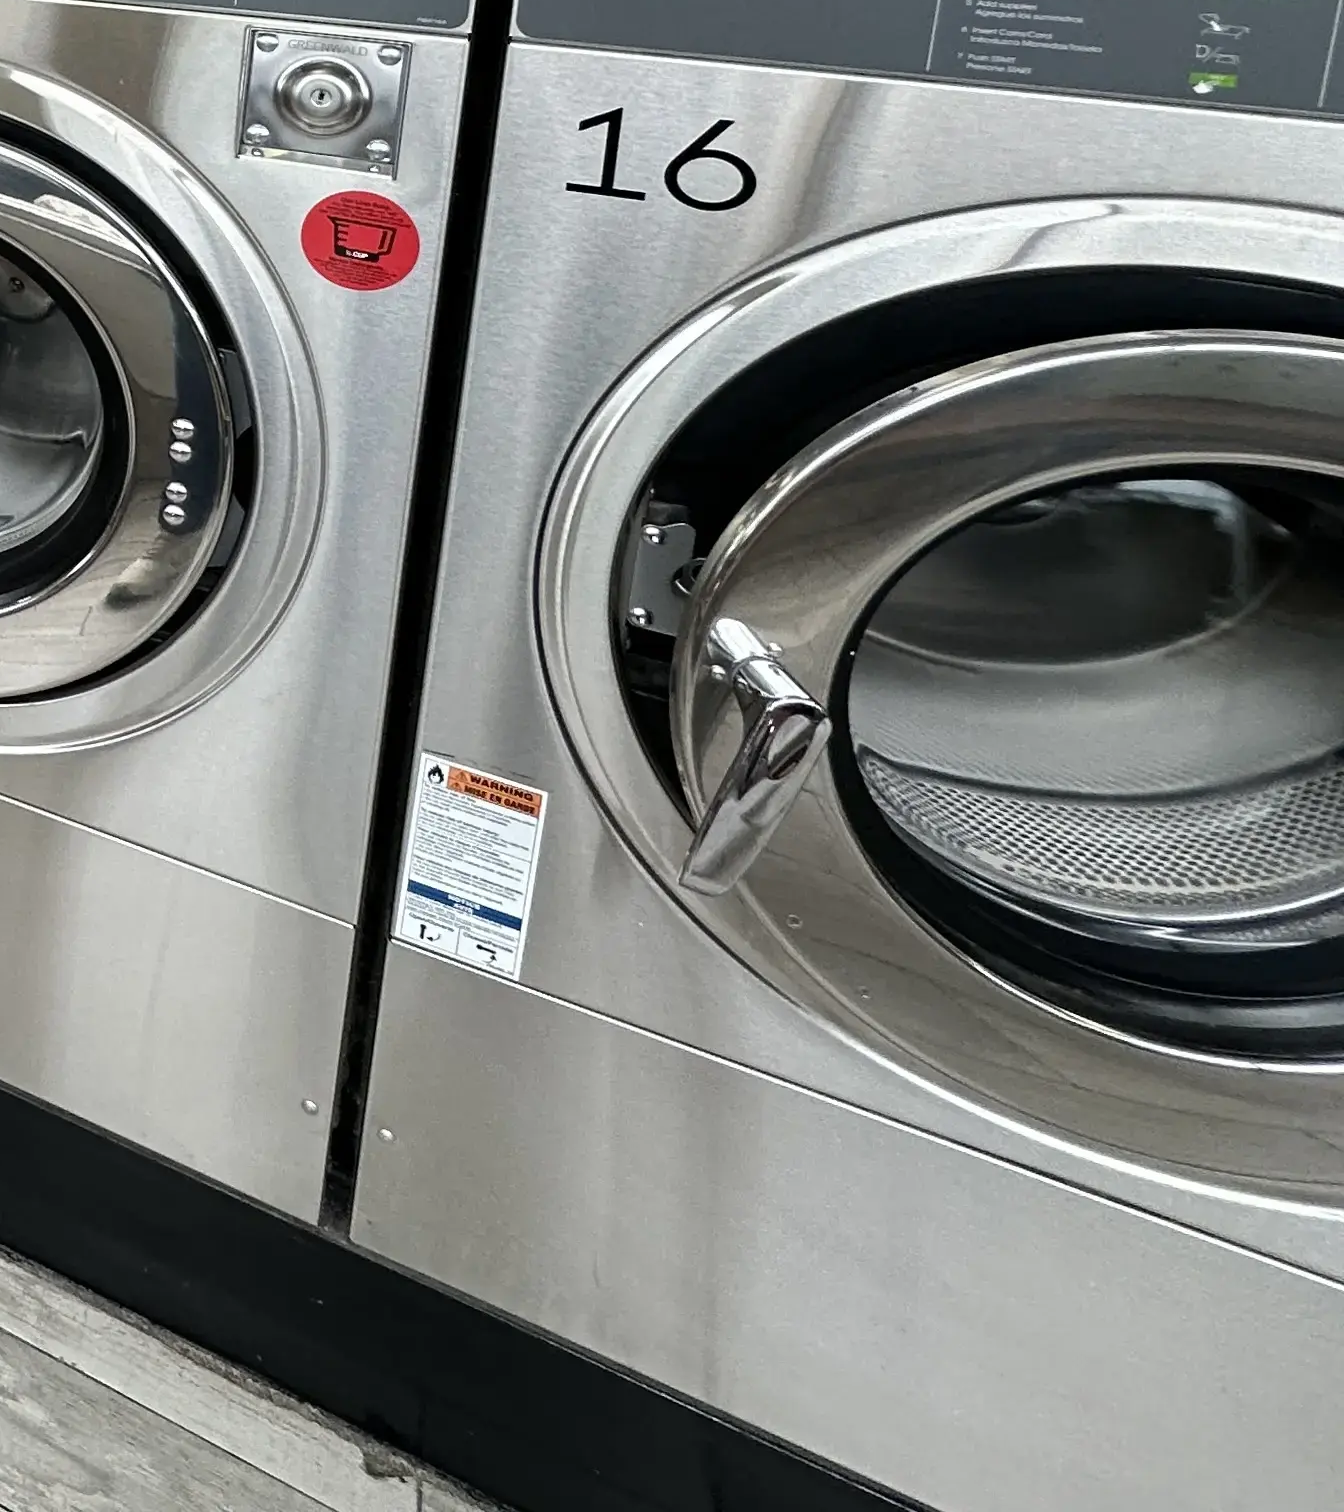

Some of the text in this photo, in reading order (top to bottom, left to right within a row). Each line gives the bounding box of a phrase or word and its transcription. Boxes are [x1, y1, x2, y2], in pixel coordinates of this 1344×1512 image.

[288, 39, 368, 56] GREENWALD
[565, 107, 757, 212] 16
[470, 774, 534, 802] WARNING
